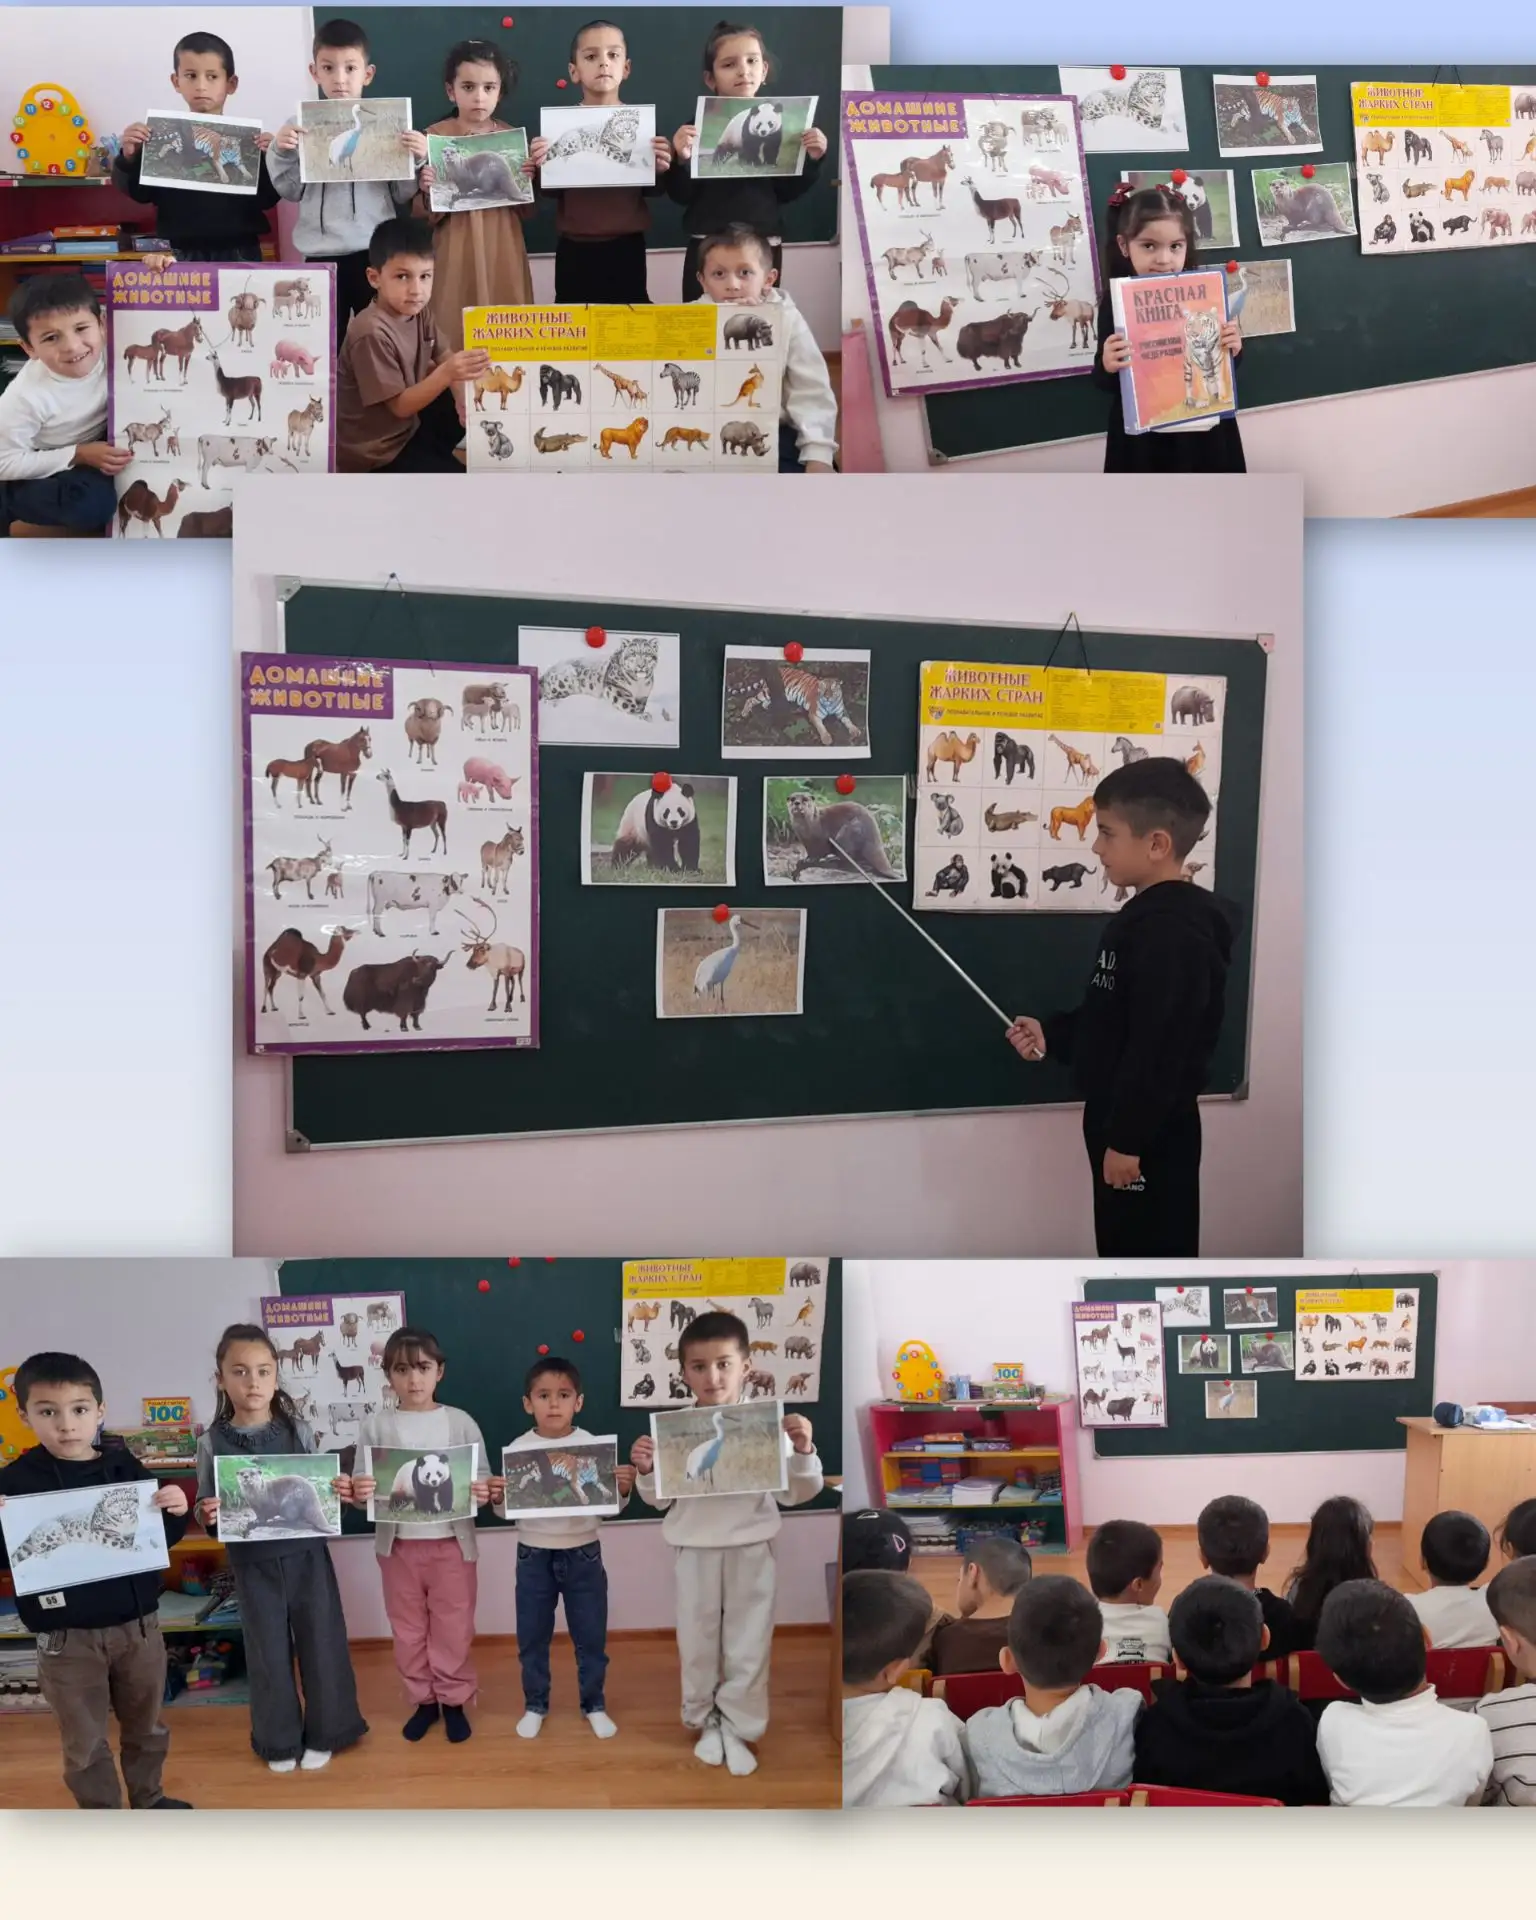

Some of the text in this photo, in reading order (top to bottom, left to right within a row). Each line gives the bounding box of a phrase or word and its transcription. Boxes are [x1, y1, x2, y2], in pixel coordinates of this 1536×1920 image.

[1368, 87, 1425, 98] ЖИВОТНЫЕ
[847, 101, 958, 117] ДОМАШНИЕ
[1358, 99, 1434, 110] ЖАРКИХ СТРАН
[848, 119, 960, 133] ЖИВОТНЫЕ
[113, 272, 211, 288] ДОМАШНИЕ
[113, 289, 211, 304] ЖИВОТНЫЕ
[1133, 284, 1207, 307] КРАСНАЯ
[486, 311, 574, 325] ЖИВОТНЫЕ
[1135, 303, 1184, 325] КНИГА
[472, 326, 587, 340] ЖАРКИХ СТРАН
[249, 664, 385, 688] ДОМАШНИЕ
[945, 669, 1032, 687] ЖИВОТНЫЕ
[249, 688, 386, 710] ЖИВОТНЫЕ
[929, 686, 1044, 703] ЖАРКИХ СТРАН
[266, 1301, 328, 1314] ДОМАШНИЕ
[266, 1312, 329, 1324] ЖИВОТНЫЕ
[148, 1406, 185, 1422] 100
